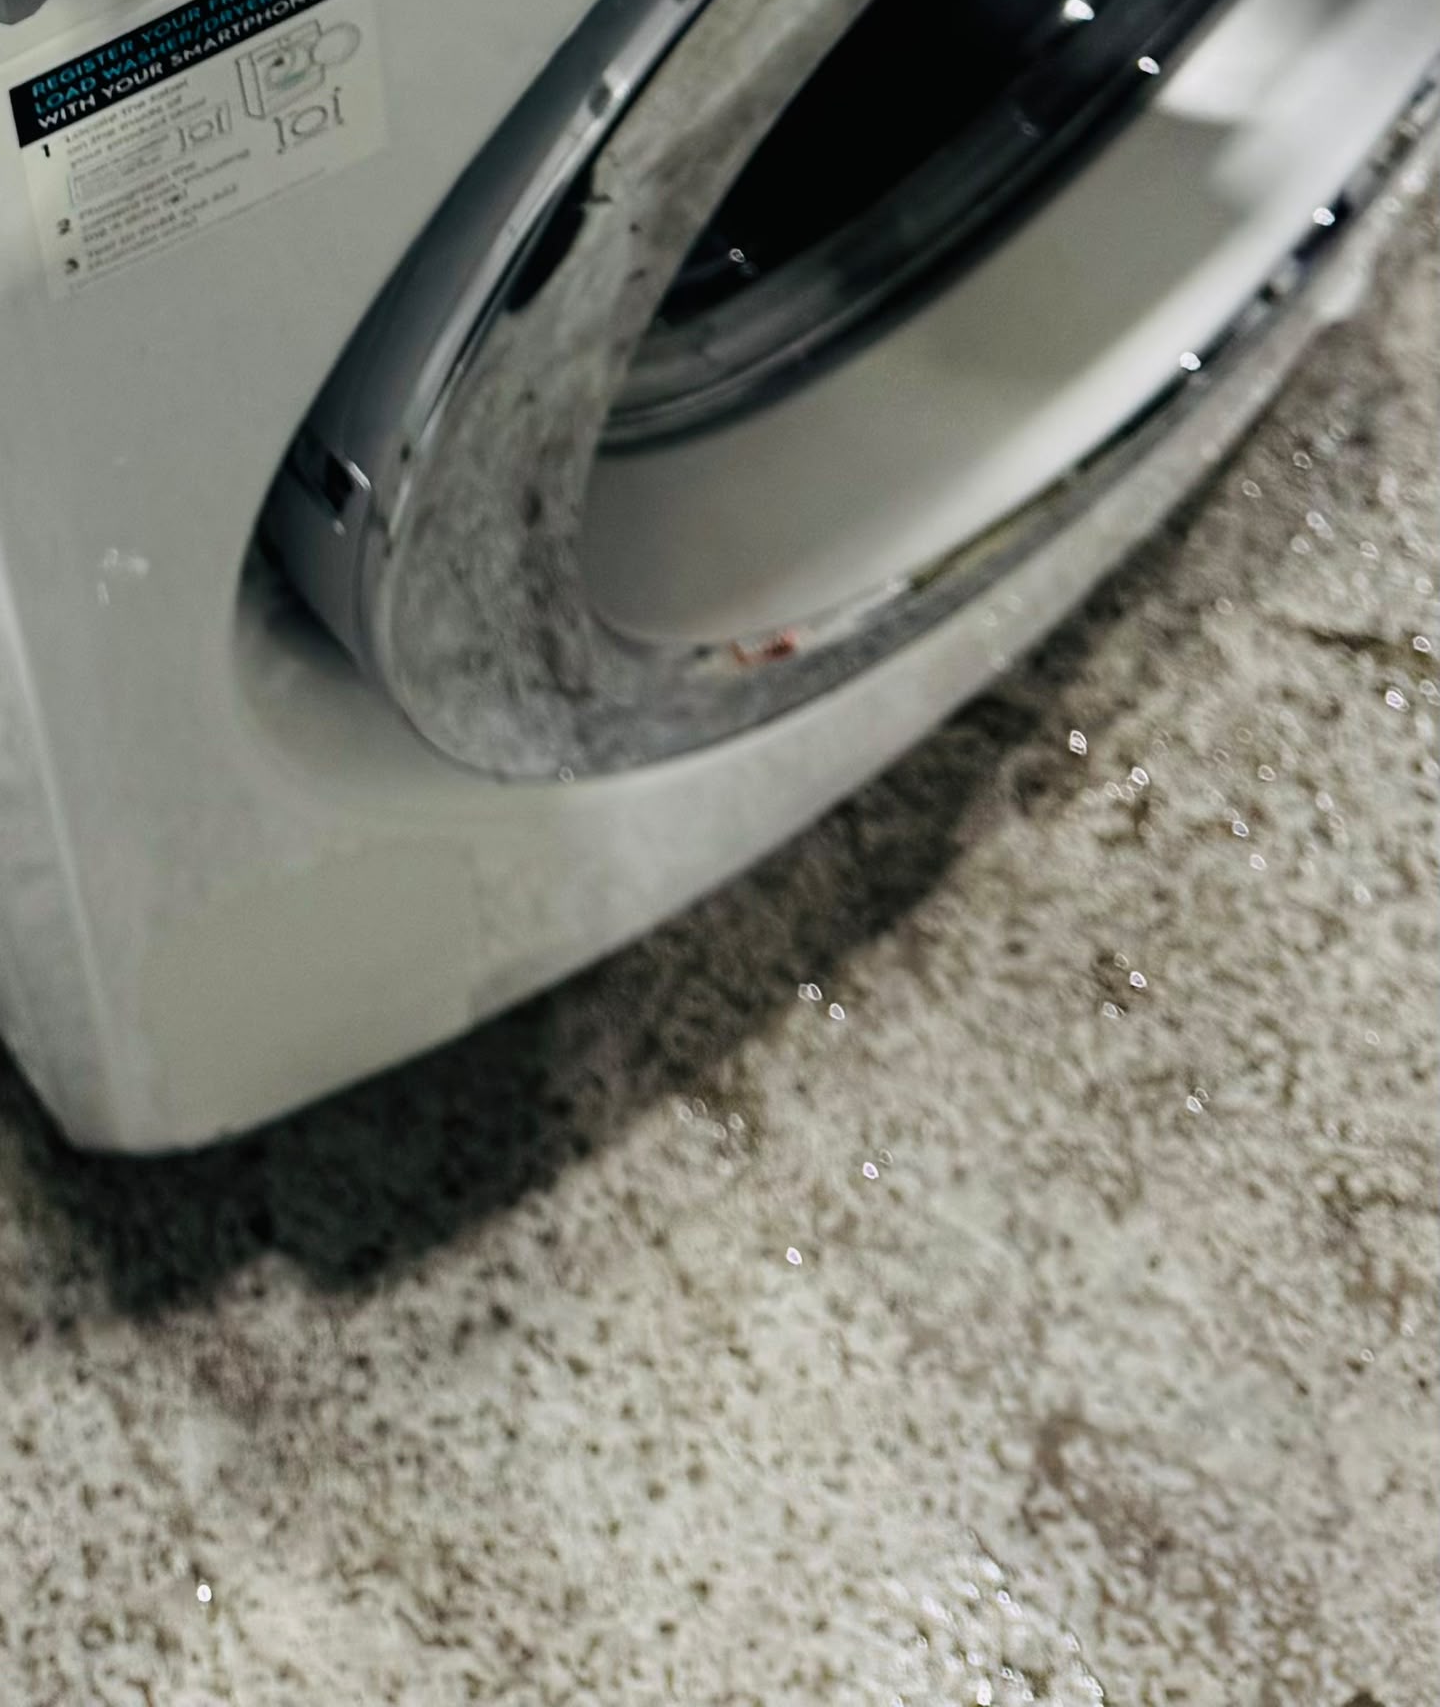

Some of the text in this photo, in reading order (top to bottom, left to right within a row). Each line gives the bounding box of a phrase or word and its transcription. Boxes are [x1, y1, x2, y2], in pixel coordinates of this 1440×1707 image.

[32, 40, 133, 98] REGISTER
[142, 7, 200, 43] YOUR
[34, 77, 97, 115] LOAD
[37, 94, 97, 130] WITH
[101, 62, 163, 99] YOUR
